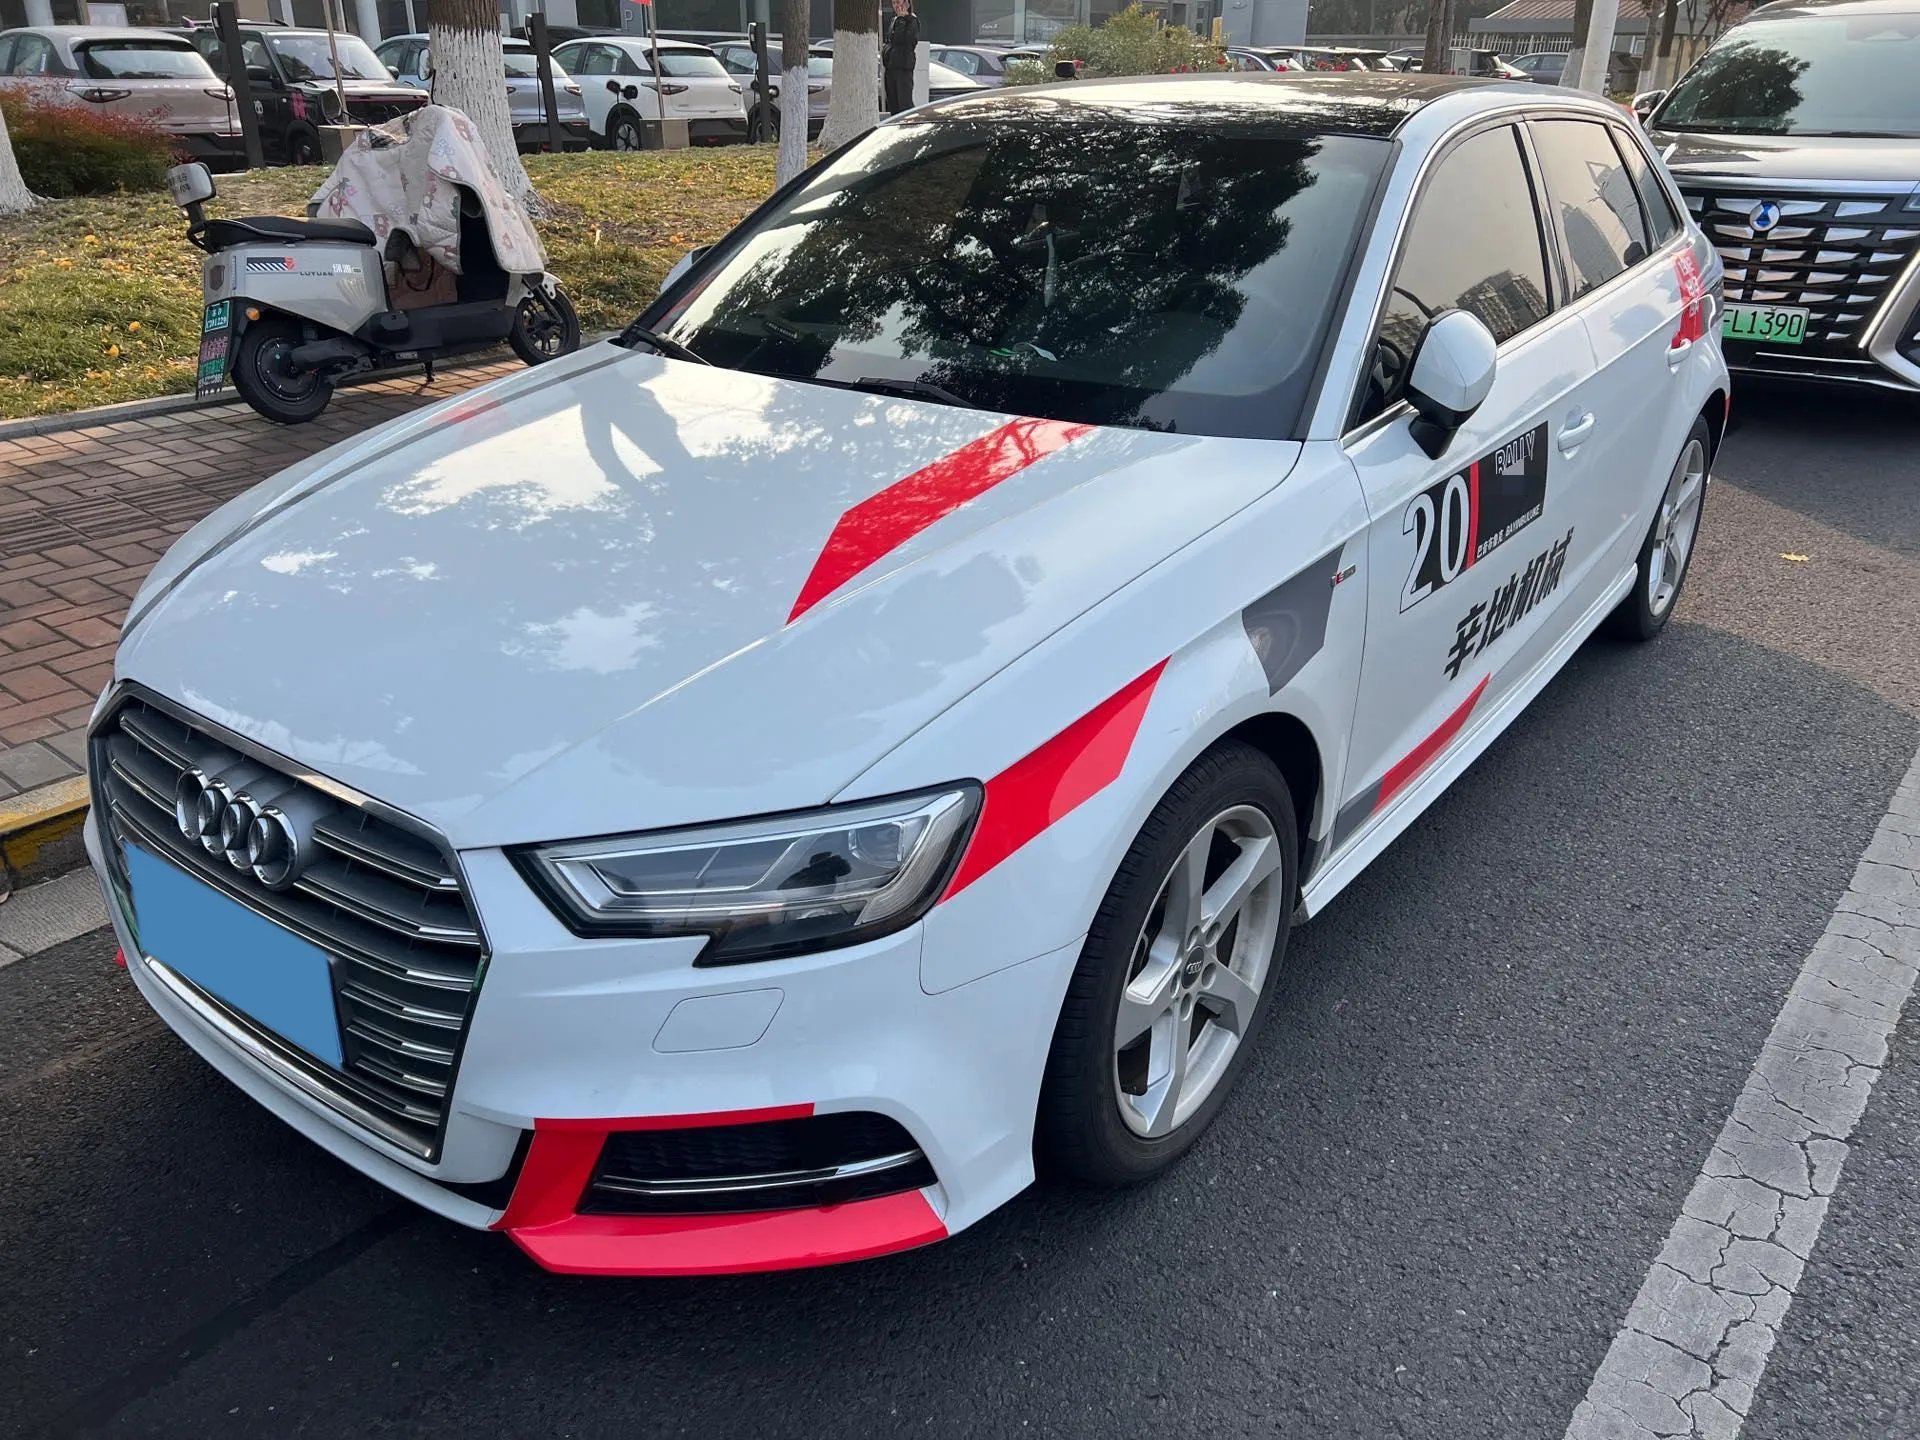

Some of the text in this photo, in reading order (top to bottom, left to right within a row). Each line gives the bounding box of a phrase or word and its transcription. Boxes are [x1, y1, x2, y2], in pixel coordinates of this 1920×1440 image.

[1399, 474, 1470, 614] 20
[1443, 526, 1575, 681] 辛地机械
